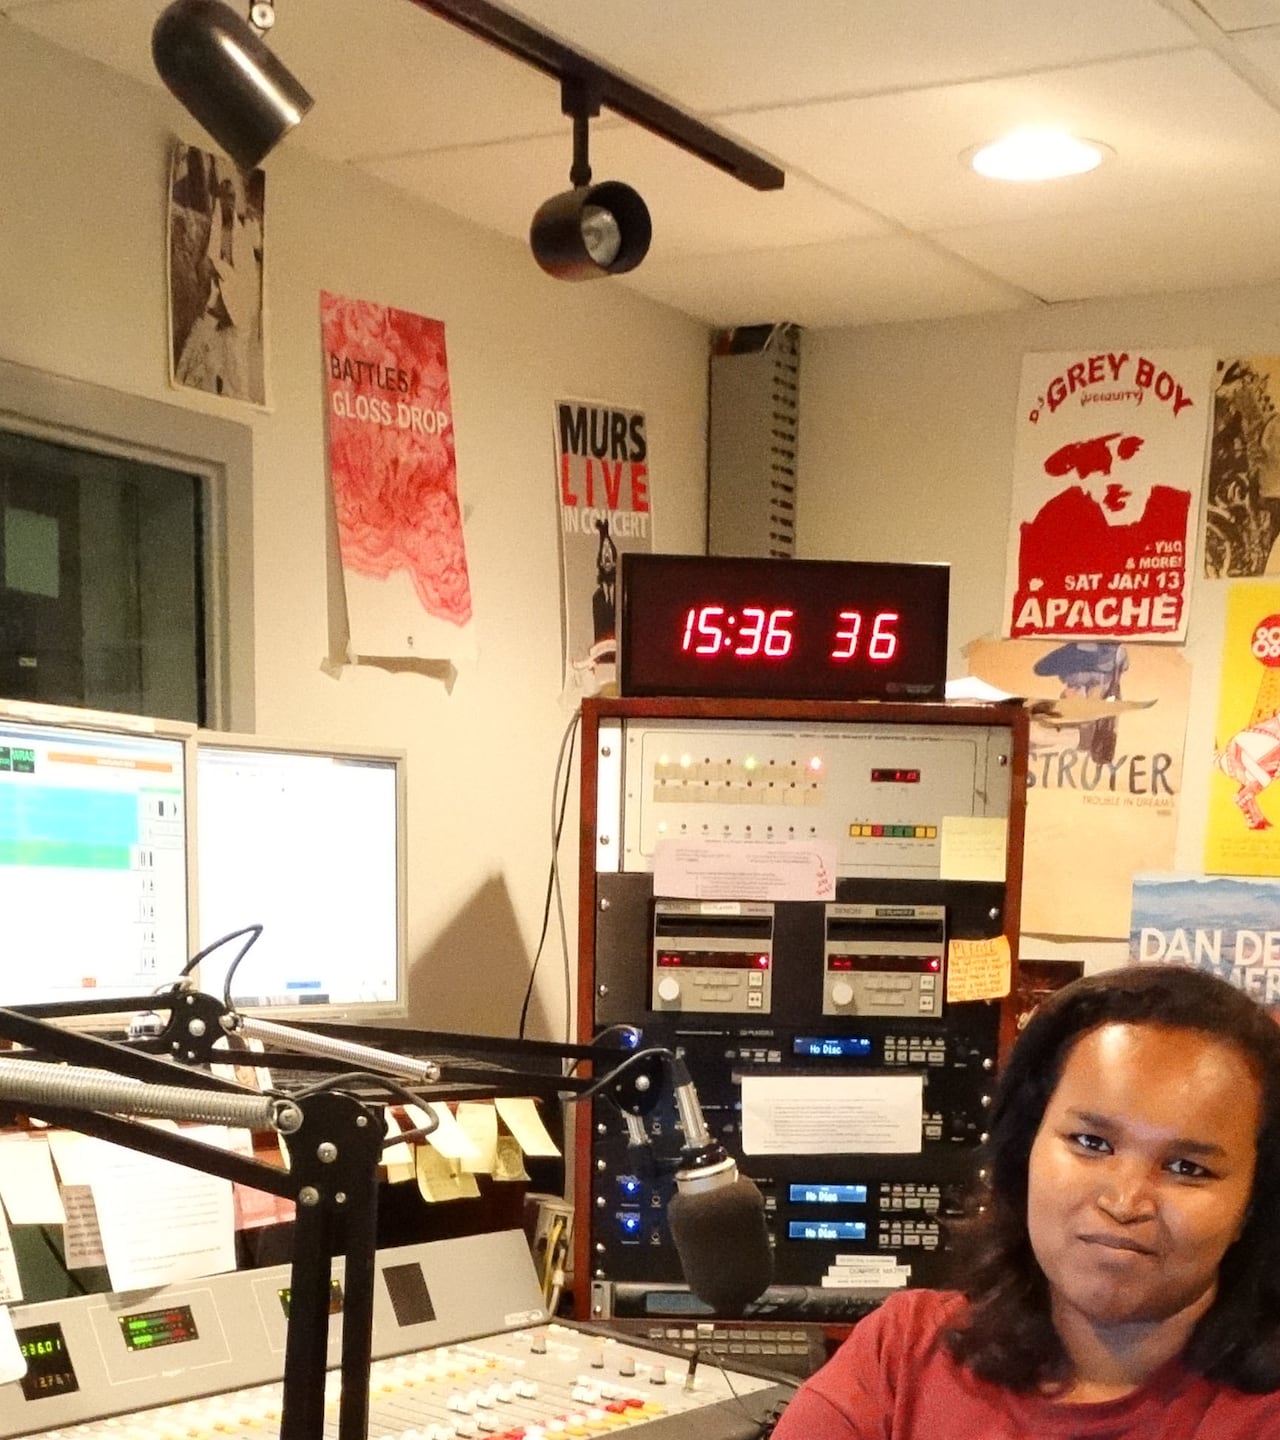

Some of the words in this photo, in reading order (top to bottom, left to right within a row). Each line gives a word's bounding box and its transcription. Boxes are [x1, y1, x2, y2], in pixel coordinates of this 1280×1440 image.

[329, 354, 411, 394] BATTLES
[1046, 351, 1130, 414] GREY
[1134, 356, 1195, 419] BOY
[332, 389, 393, 426] GLOSS
[397, 403, 449, 435] DROP
[558, 404, 648, 463] MURS
[561, 453, 650, 514] LIVE
[562, 504, 580, 534] IN
[1063, 572, 1104, 592] SAT
[1107, 572, 1151, 591] JAN
[1155, 570, 1181, 590] 13
[1124, 556, 1137, 571] &
[1014, 594, 1179, 630] APACHE
[681, 606, 795, 657] 15:36
[831, 612, 899, 660] 36
[1138, 926, 1221, 966] DAN
